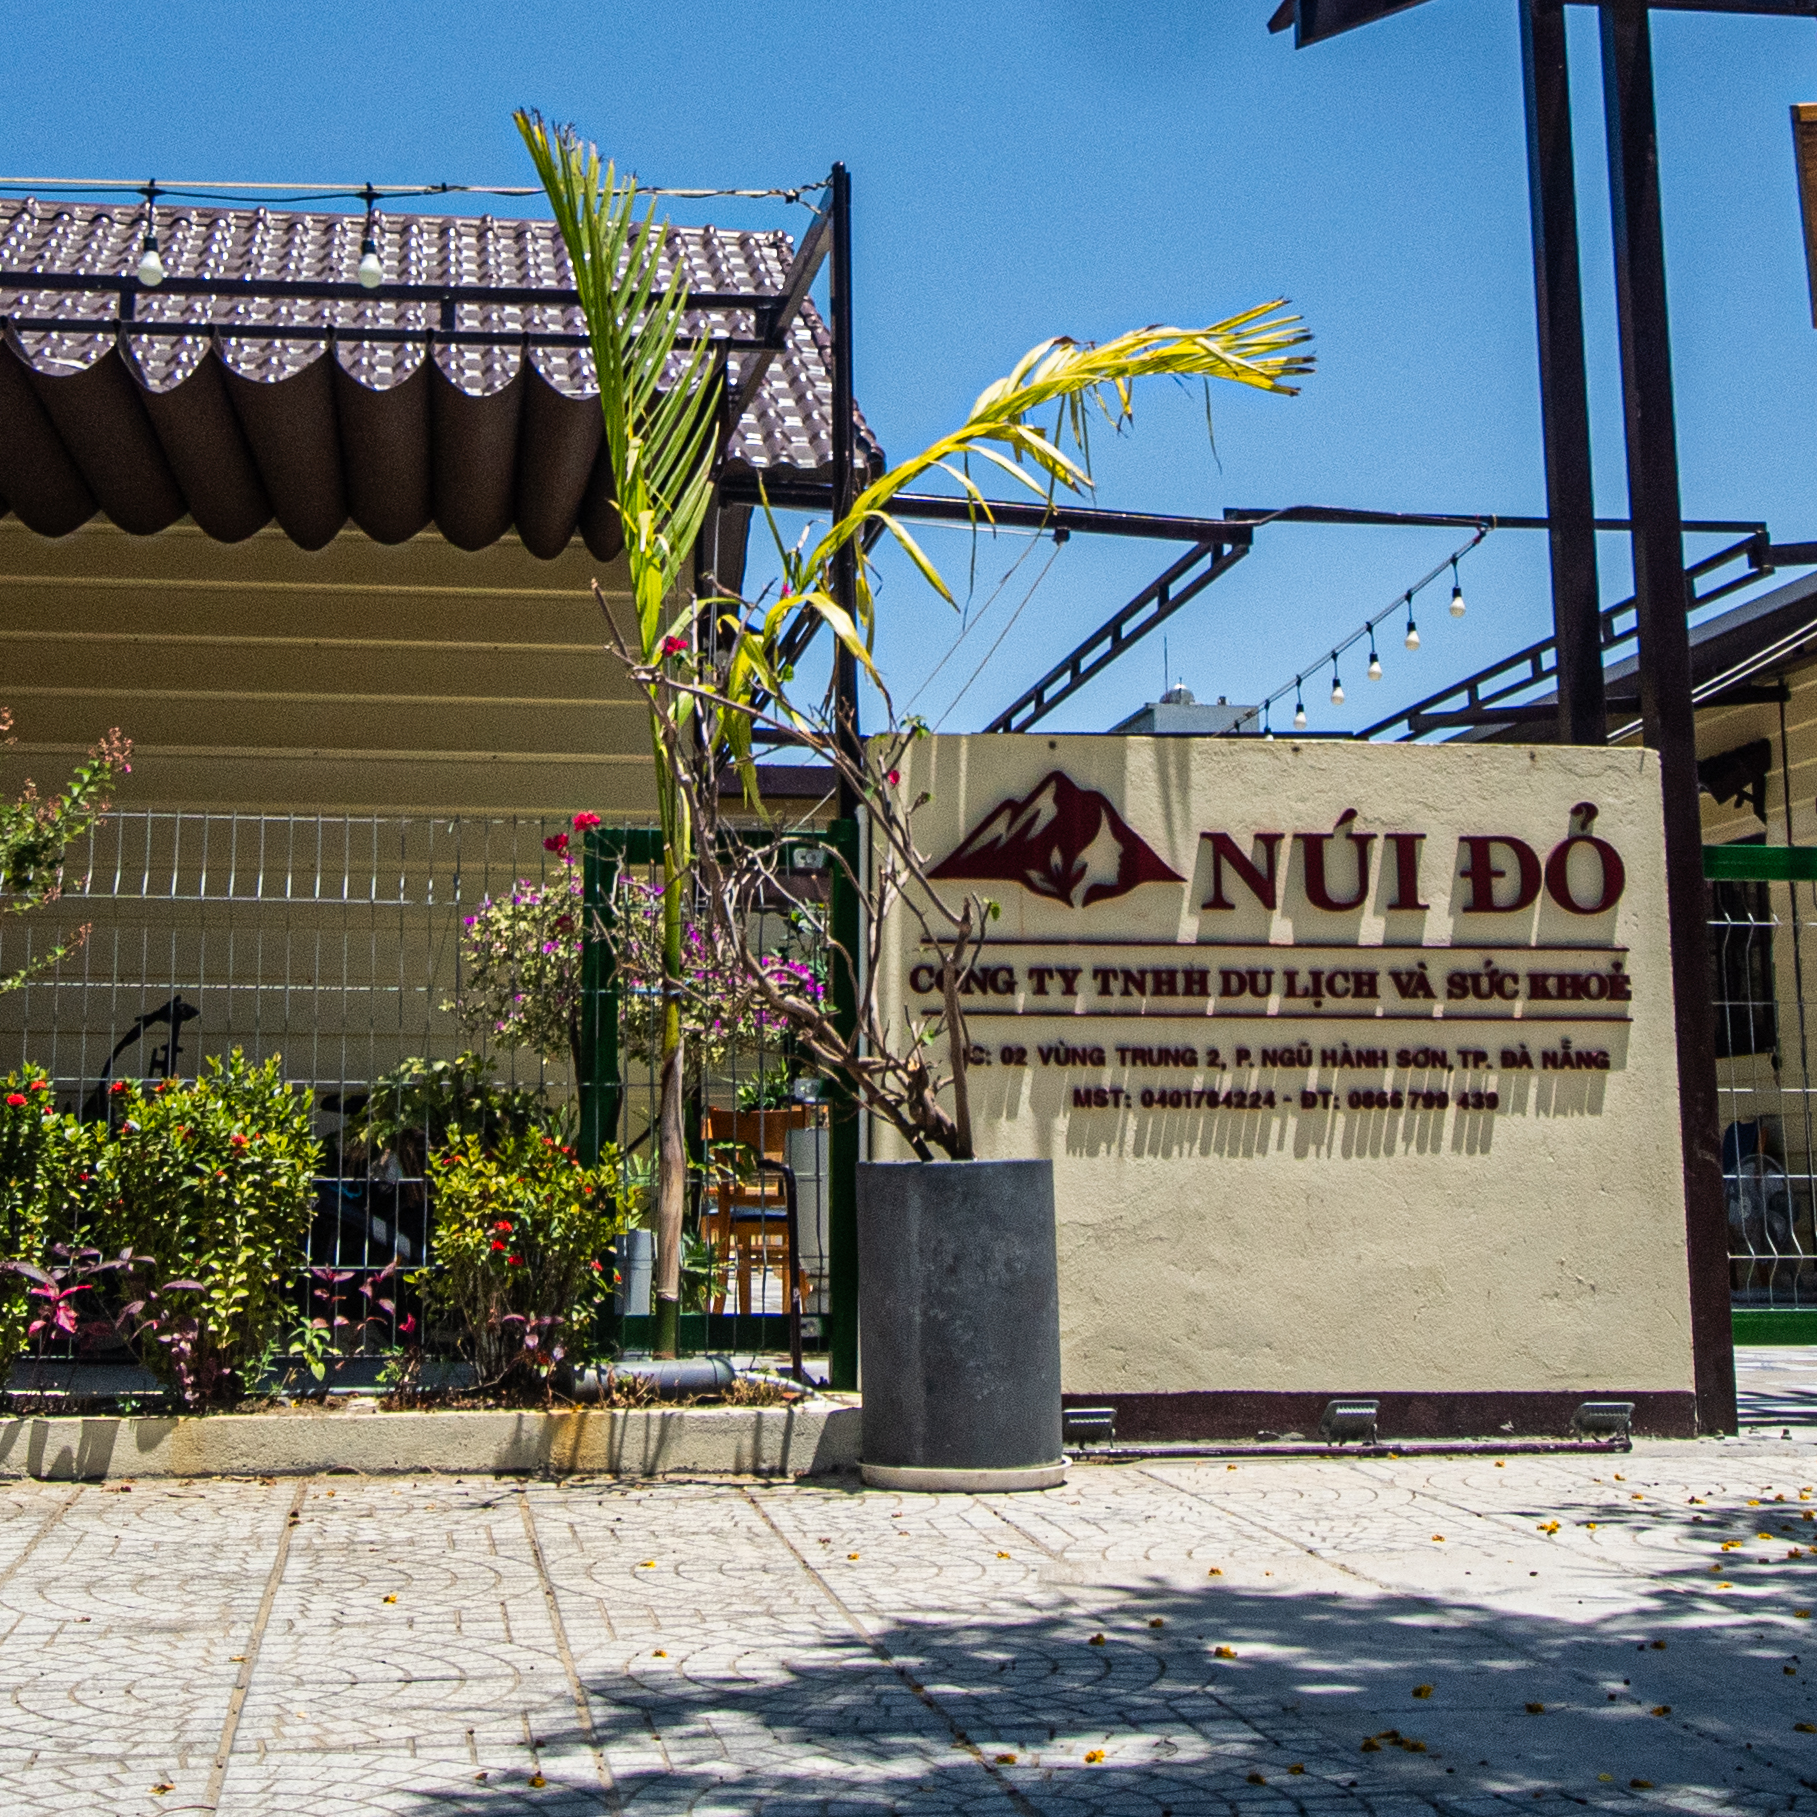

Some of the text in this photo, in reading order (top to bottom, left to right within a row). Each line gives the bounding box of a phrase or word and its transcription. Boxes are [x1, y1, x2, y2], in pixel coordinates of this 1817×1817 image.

[1199, 801, 1626, 915] NÚI ĐỎ
[1028, 966, 1082, 996] TY
[1092, 966, 1210, 997] TNHH
[1219, 968, 1275, 998] DU
[1284, 970, 1380, 1008] LỊCH
[1388, 962, 1437, 1000] VÀ
[1446, 959, 1520, 1001] SỨC
[1526, 960, 1632, 1001] KHOẺ
[1000, 1046, 1028, 1066] 02
[1037, 1039, 1106, 1067] VÙNG
[1116, 1046, 1198, 1068] TRUNG
[1206, 1047, 1228, 1071] 2,
[1236, 1047, 1255, 1069] P.
[1261, 1040, 1313, 1069] NGŨ
[1321, 1041, 1389, 1069] HÀNH
[1396, 1048, 1454, 1073] SƠN,
[1456, 1049, 1493, 1070] TP.
[1500, 1042, 1534, 1070] ĐÀ
[1541, 1037, 1611, 1070] NẴNG
[1072, 1088, 1132, 1109] MST:
[1300, 1090, 1340, 1110] ĐT:
